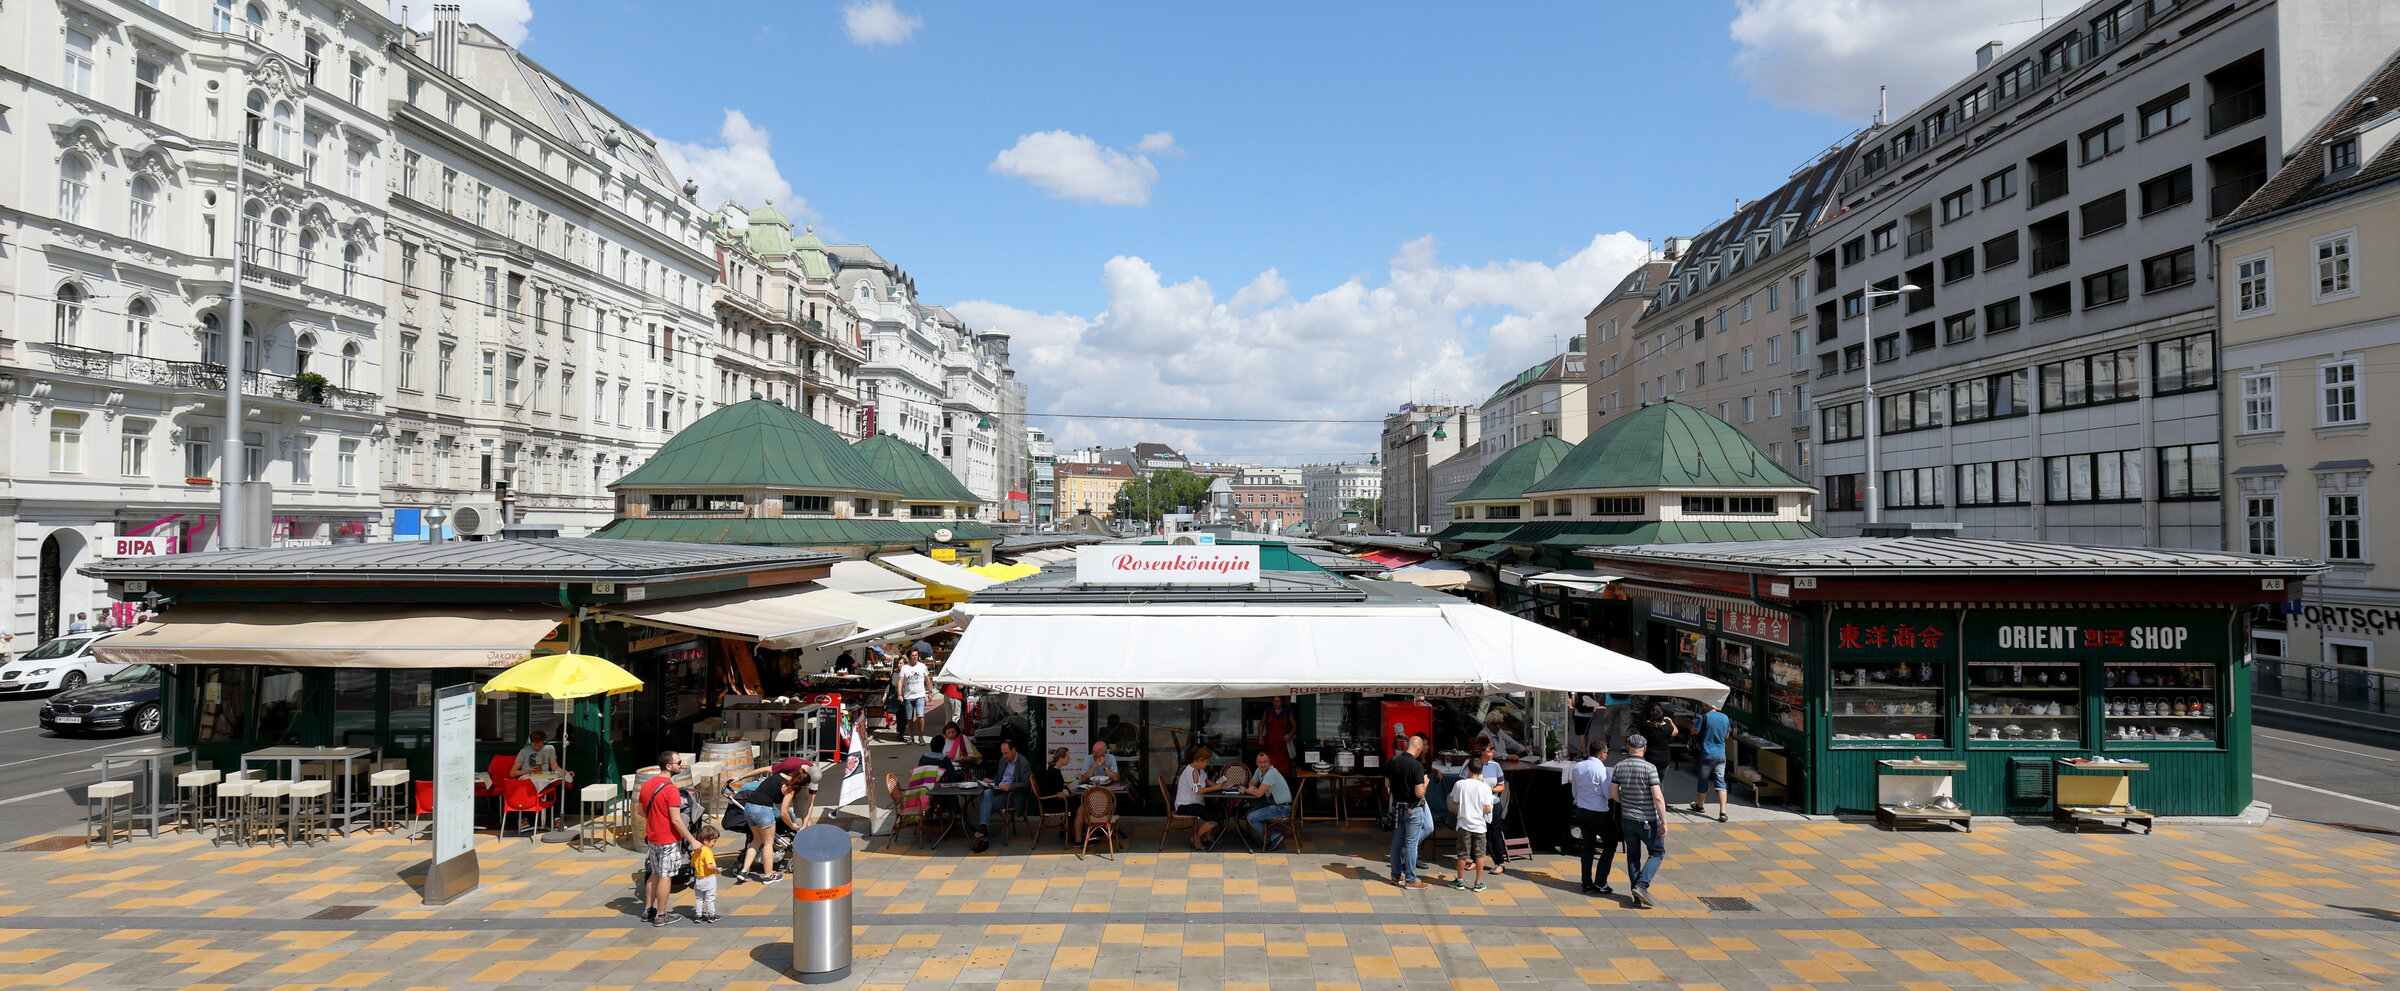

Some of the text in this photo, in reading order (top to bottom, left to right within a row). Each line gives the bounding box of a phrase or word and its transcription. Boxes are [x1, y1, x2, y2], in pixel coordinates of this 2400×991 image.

[117, 540, 156, 555] BIPA
[1112, 554, 1251, 574] Rosenkönigin
[1798, 579, 1813, 587] A 8
[2266, 580, 2280, 588] A 8
[1681, 603, 1699, 621] SHOP
[1838, 624, 1945, 649] 東洋商会
[1999, 626, 2188, 649] ORIENT 한국 SHOP
[1037, 686, 1145, 699] DELIKATESSEN
